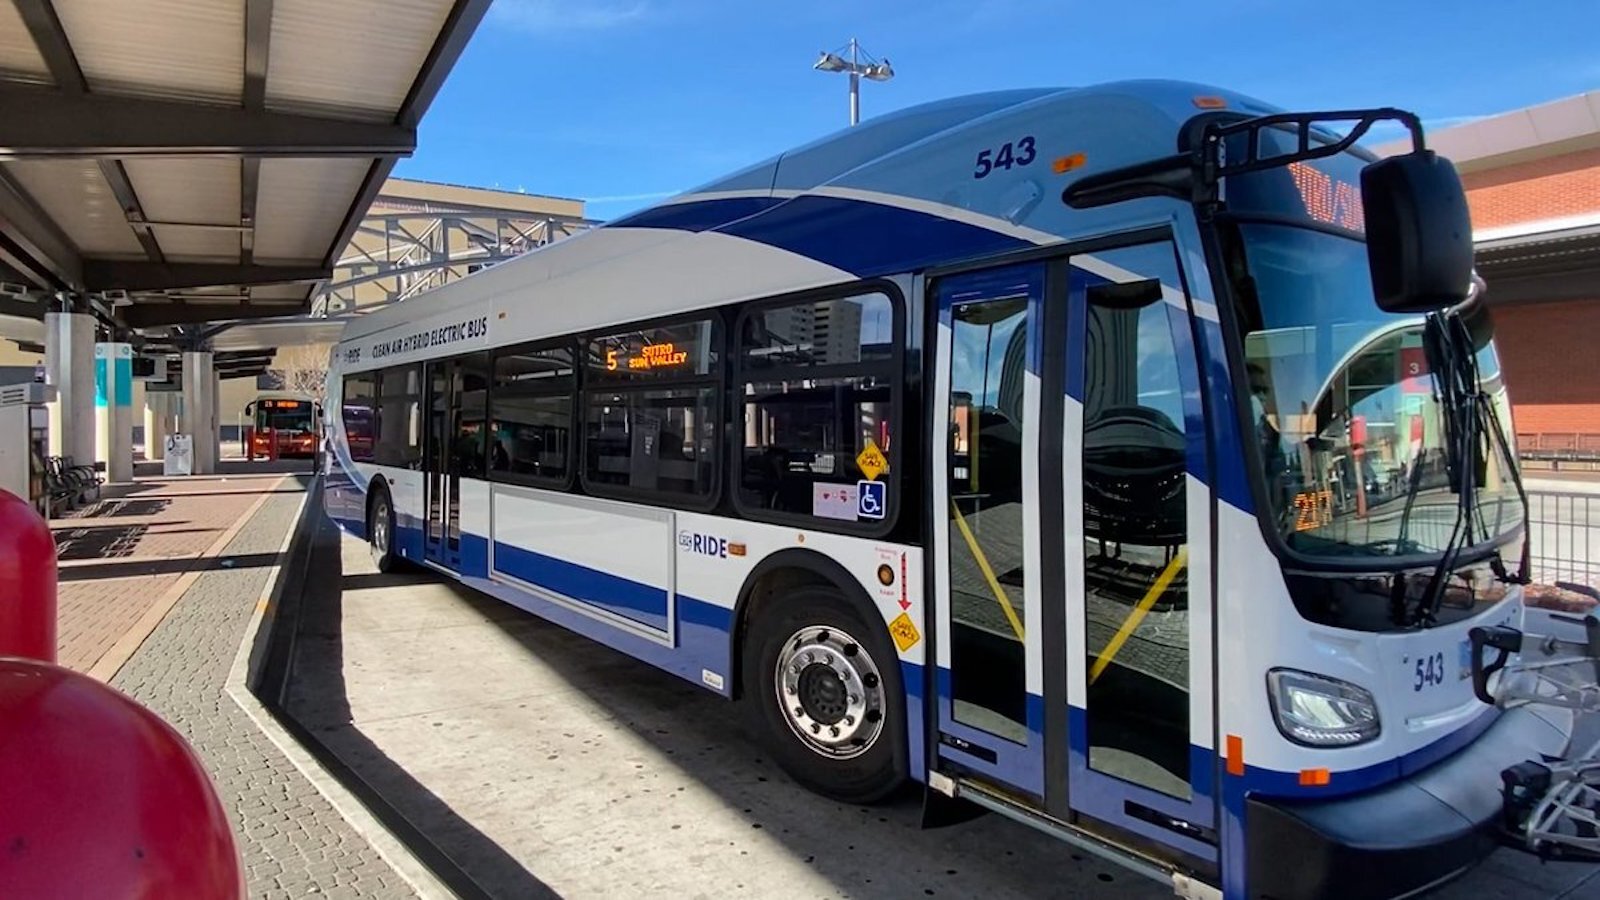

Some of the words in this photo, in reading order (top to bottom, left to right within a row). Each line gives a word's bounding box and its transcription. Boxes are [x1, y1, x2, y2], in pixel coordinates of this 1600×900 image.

[974, 136, 1036, 179] 543
[372, 342, 390, 359] CLEAN
[391, 338, 402, 354] AIR
[403, 331, 430, 351] HYBRID
[430, 322, 466, 346] ELECTRIC
[467, 317, 487, 338] BUS
[607, 351, 618, 371] 5
[628, 357, 650, 370] SUN
[650, 352, 687, 366] VALLEY
[641, 343, 674, 358] SUTRO
[1410, 362, 1419, 375] 3
[693, 533, 727, 559] RIDE
[1414, 651, 1444, 692] 543
